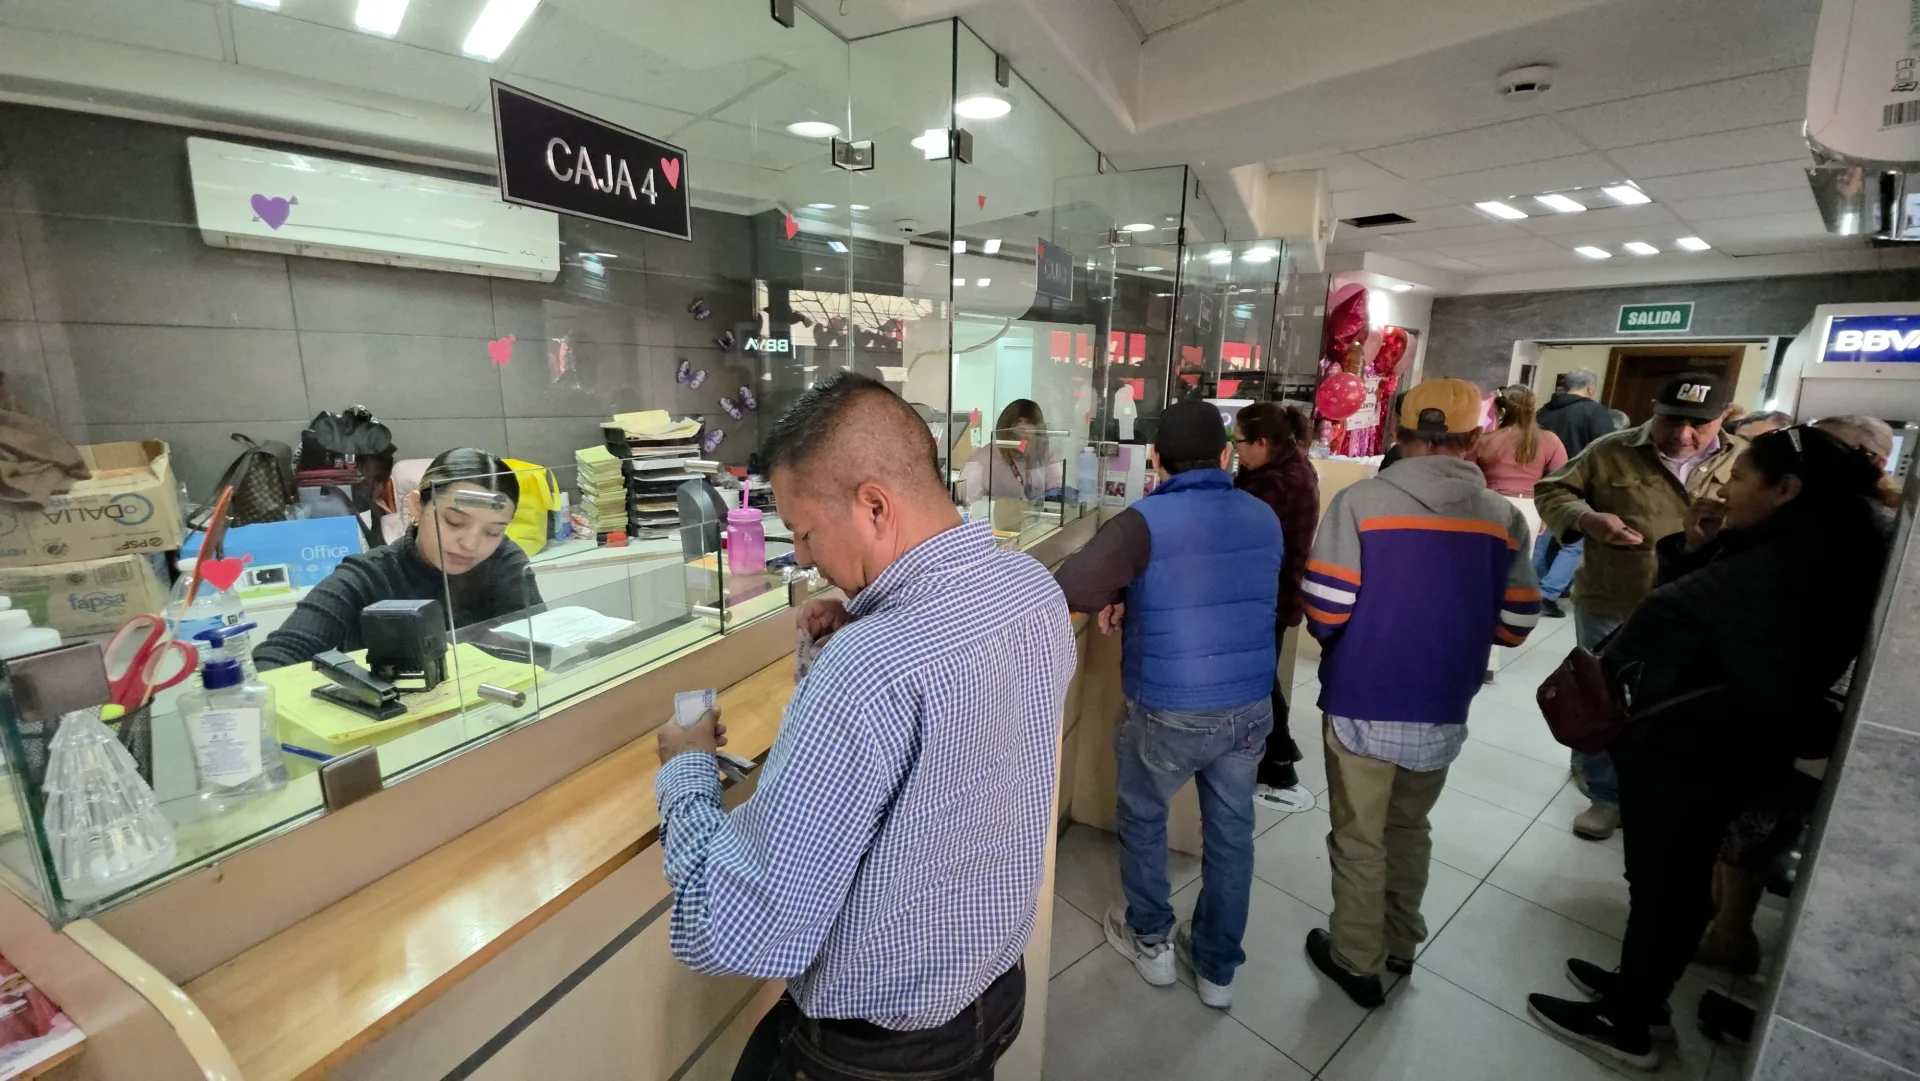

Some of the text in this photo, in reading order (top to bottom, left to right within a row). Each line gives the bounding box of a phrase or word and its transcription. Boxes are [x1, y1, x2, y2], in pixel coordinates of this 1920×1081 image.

[547, 136, 658, 205] CAJA 4
[1627, 310, 1682, 326] SALIDA
[1676, 383, 1711, 403] CAT
[42, 504, 124, 525] DALIA
[301, 544, 349, 561] Office
